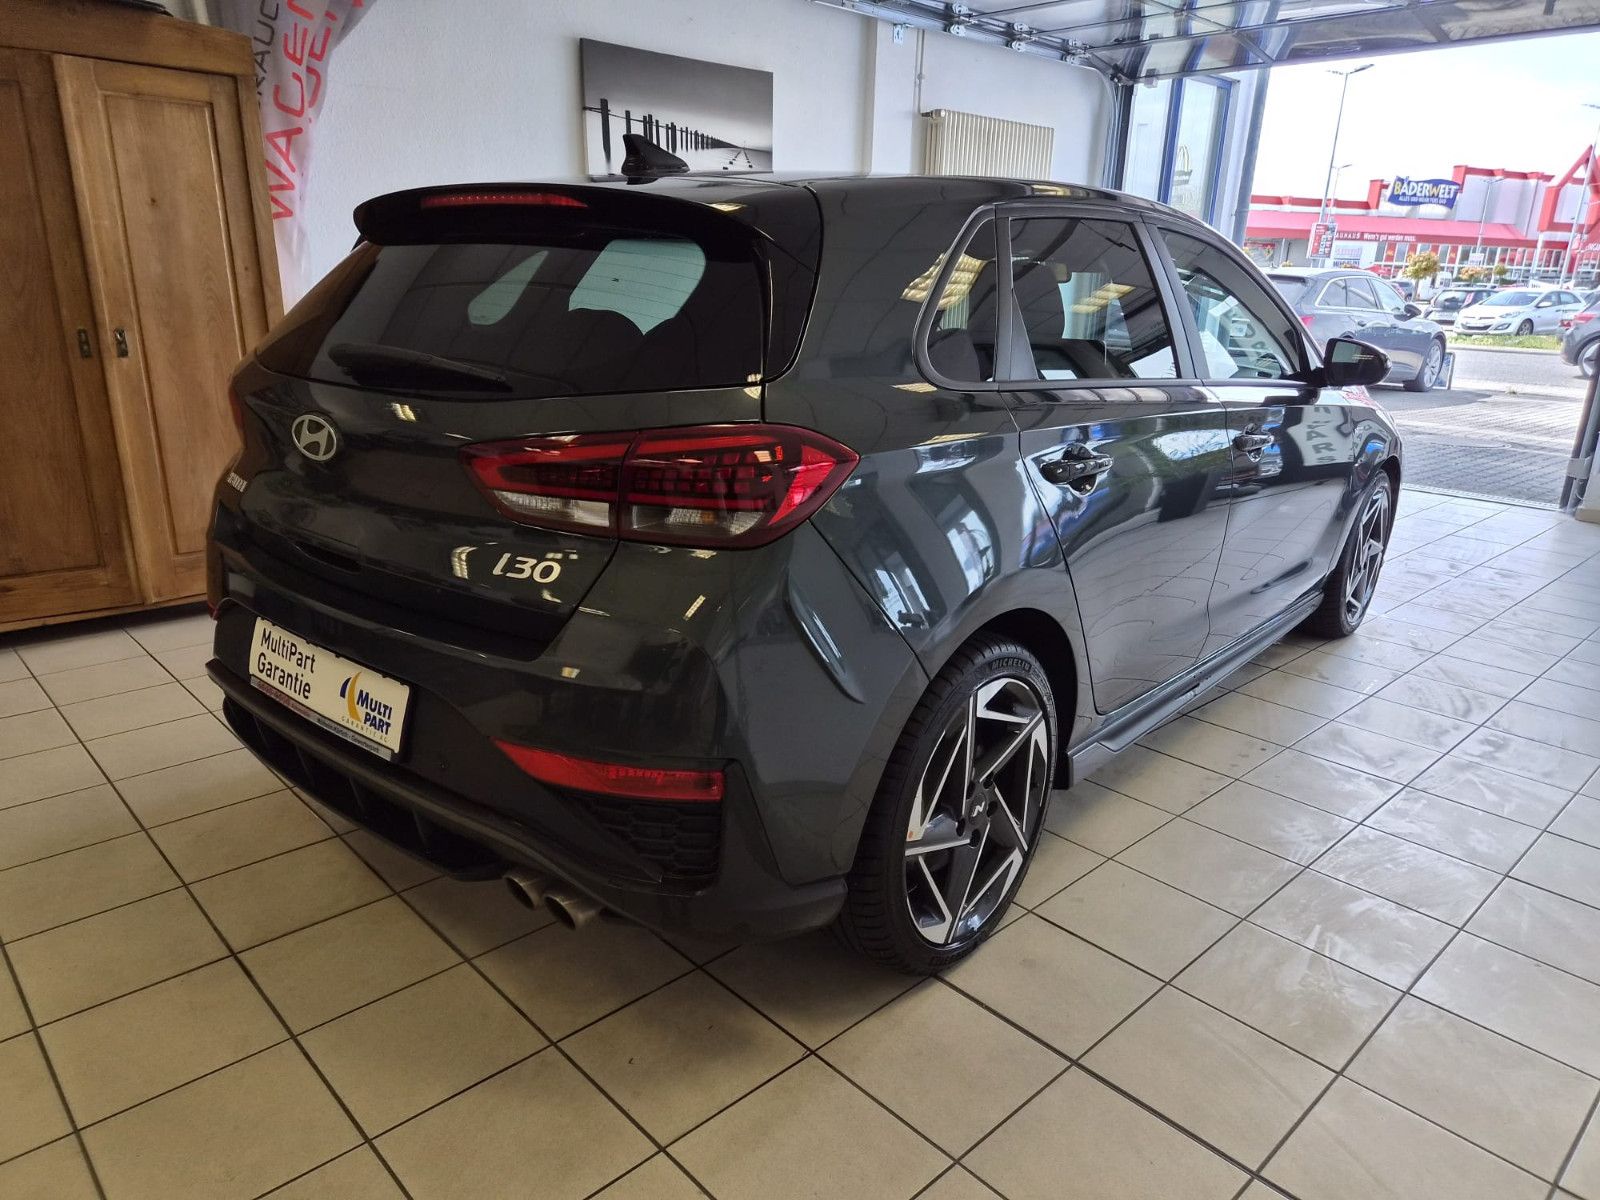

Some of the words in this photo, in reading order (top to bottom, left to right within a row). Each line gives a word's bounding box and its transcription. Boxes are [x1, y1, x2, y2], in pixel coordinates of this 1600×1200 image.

[1333, 231, 1360, 239] AUHAUS
[261, 628, 316, 673] MultiPart
[257, 652, 311, 699] Garantie
[992, 658, 1032, 671] MICHELIN
[356, 689, 392, 720] MULTI
[363, 711, 391, 735] PART
